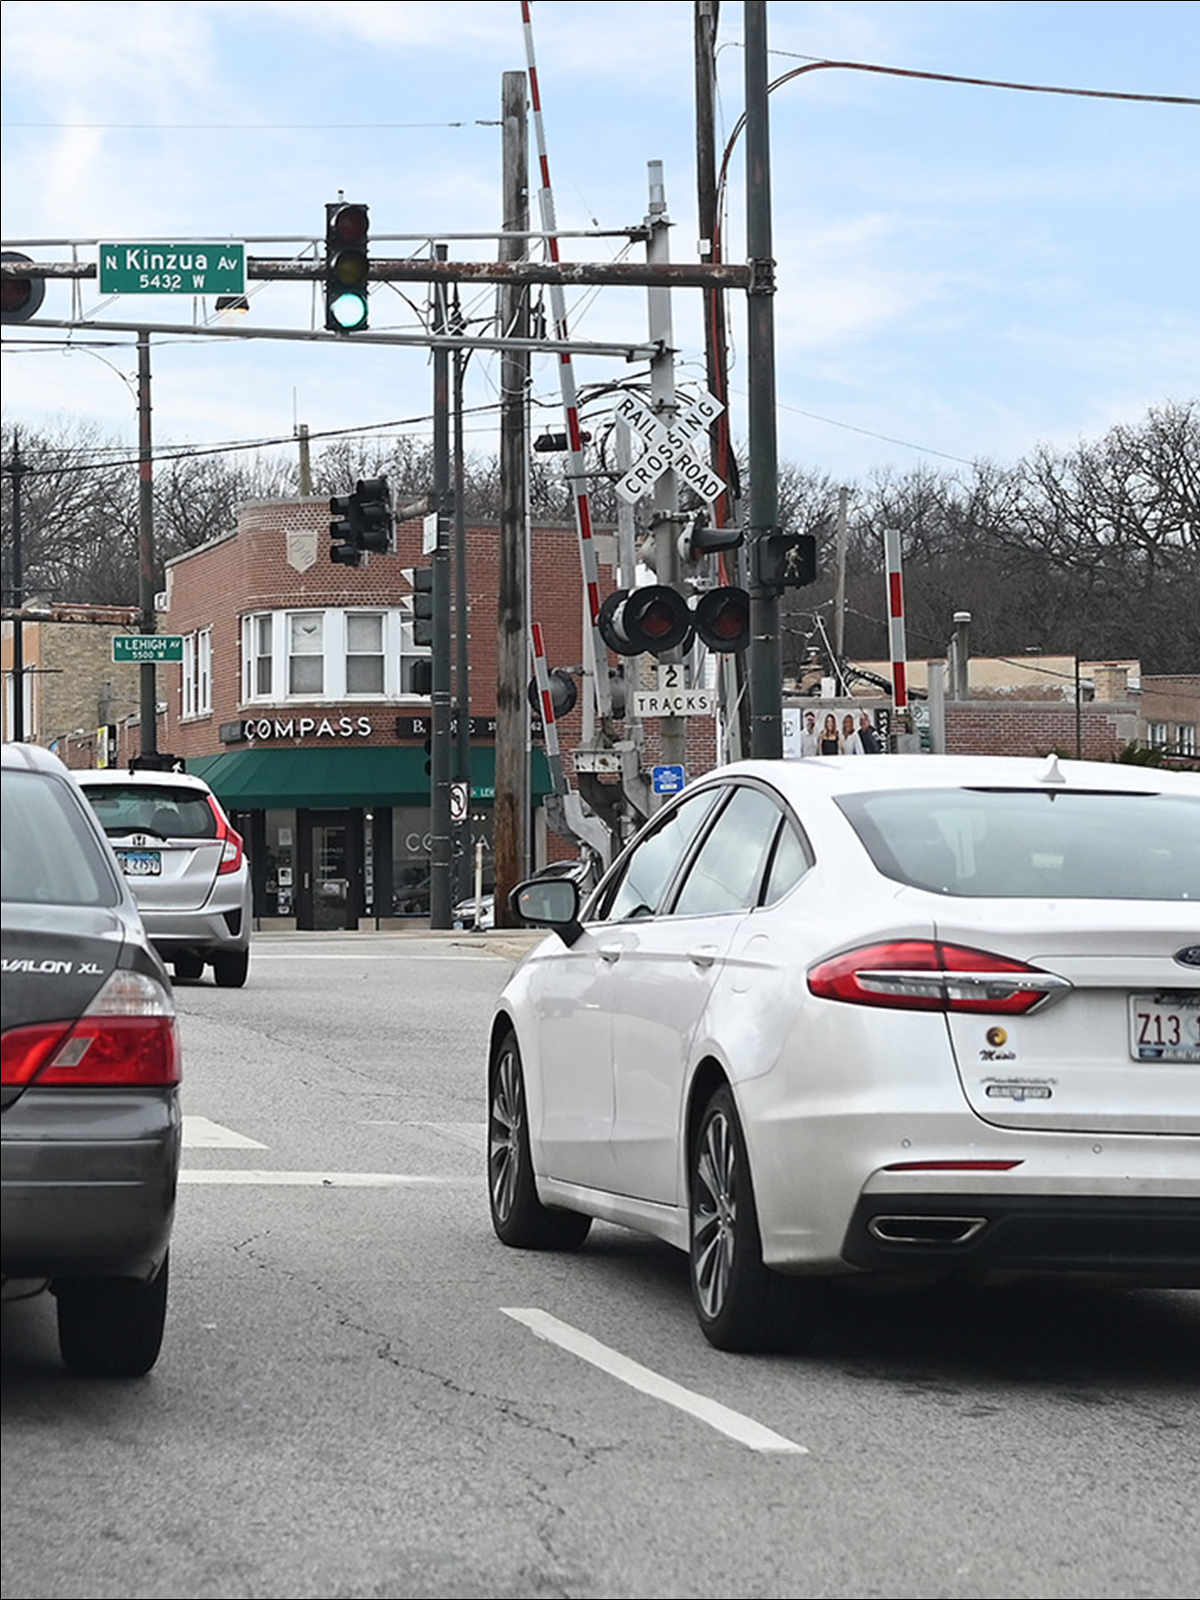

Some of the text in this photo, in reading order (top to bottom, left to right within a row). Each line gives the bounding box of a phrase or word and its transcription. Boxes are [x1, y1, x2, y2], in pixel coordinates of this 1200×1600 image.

[106, 249, 237, 270] N Kinzua Av
[139, 274, 205, 288] 5432 W
[618, 398, 656, 442] RAIL
[625, 401, 714, 494] CROSSING
[675, 454, 719, 497] ROAD
[115, 639, 180, 650] N LEHIGH AV
[132, 651, 164, 659] 5500 W
[665, 668, 678, 687] 2
[637, 696, 708, 711] TRACKS
[244, 716, 372, 740] COMPASS
[77, 962, 104, 974] XL
[1137, 1013, 1181, 1047] Z13
